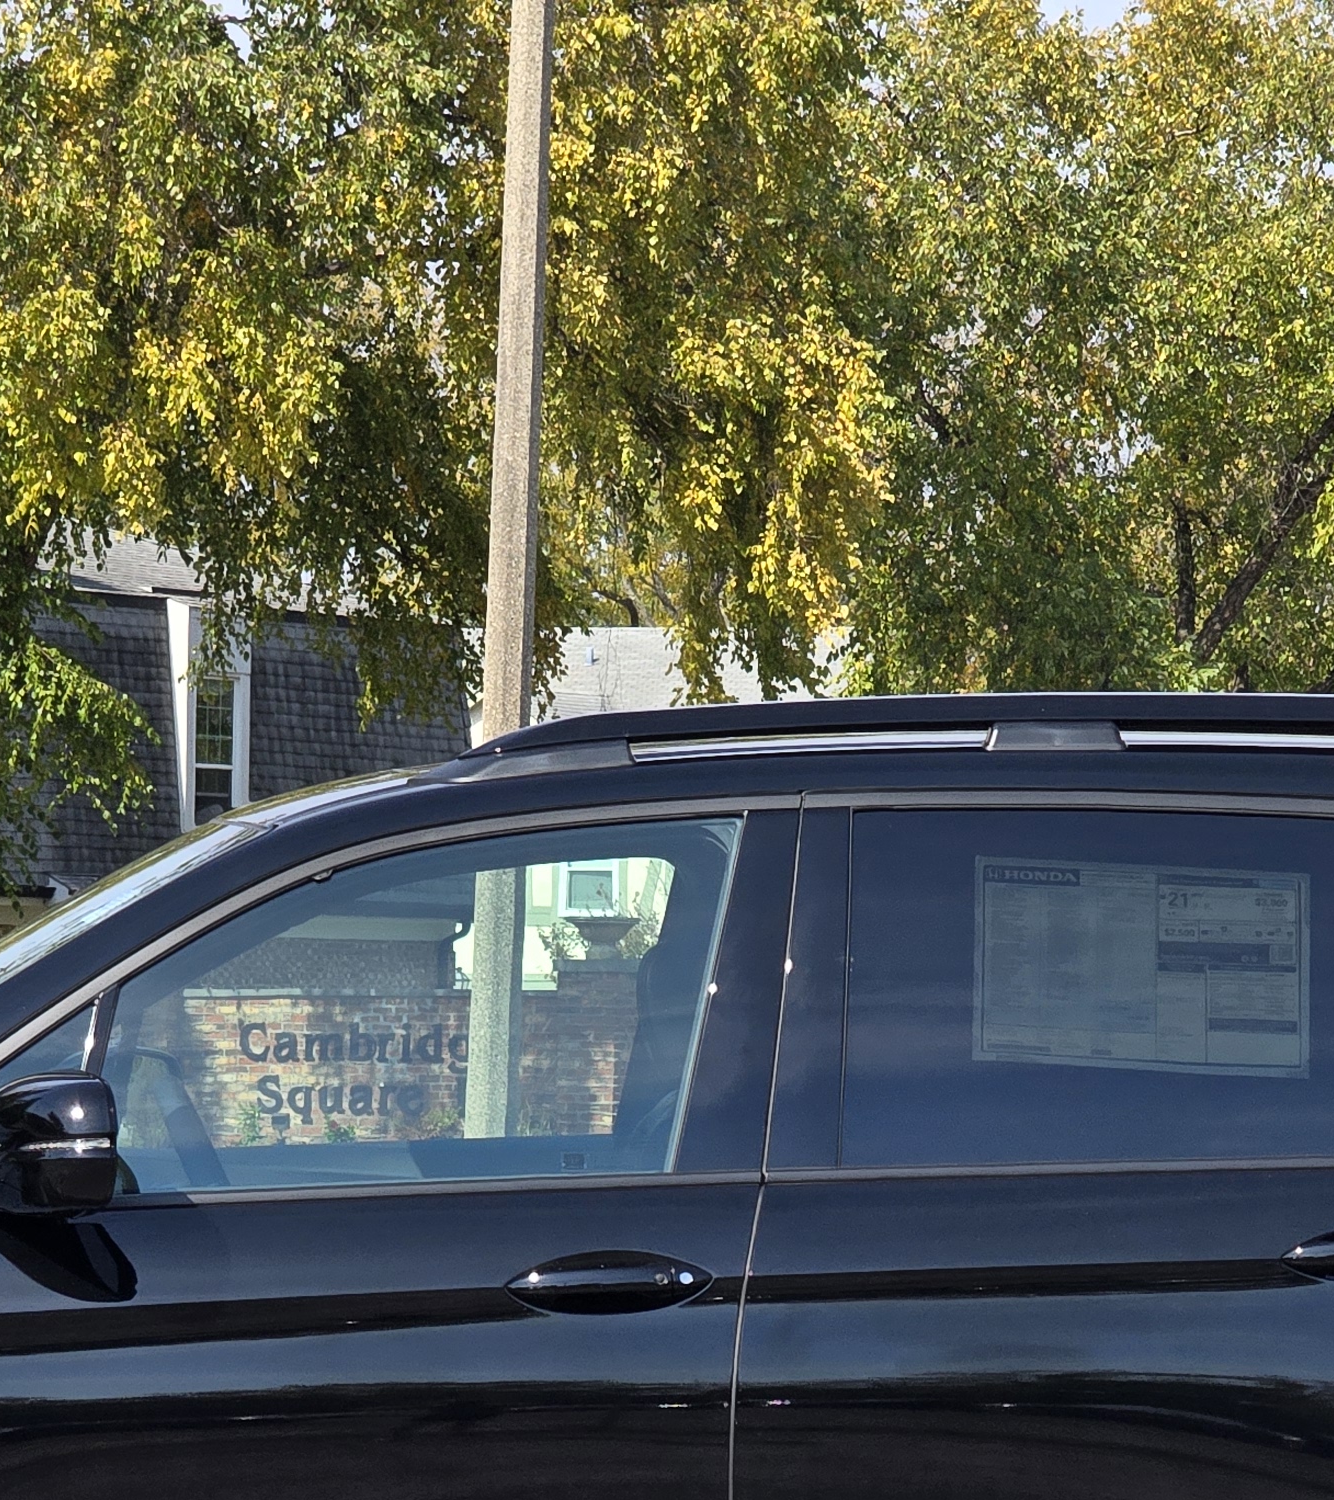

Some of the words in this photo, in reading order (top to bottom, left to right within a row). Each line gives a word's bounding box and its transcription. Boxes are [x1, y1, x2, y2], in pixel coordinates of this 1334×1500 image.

[1003, 869, 1078, 883] HONDA
[1167, 891, 1189, 908] 21
[239, 1022, 469, 1074] Cambridg
[257, 1074, 427, 1125] Square
